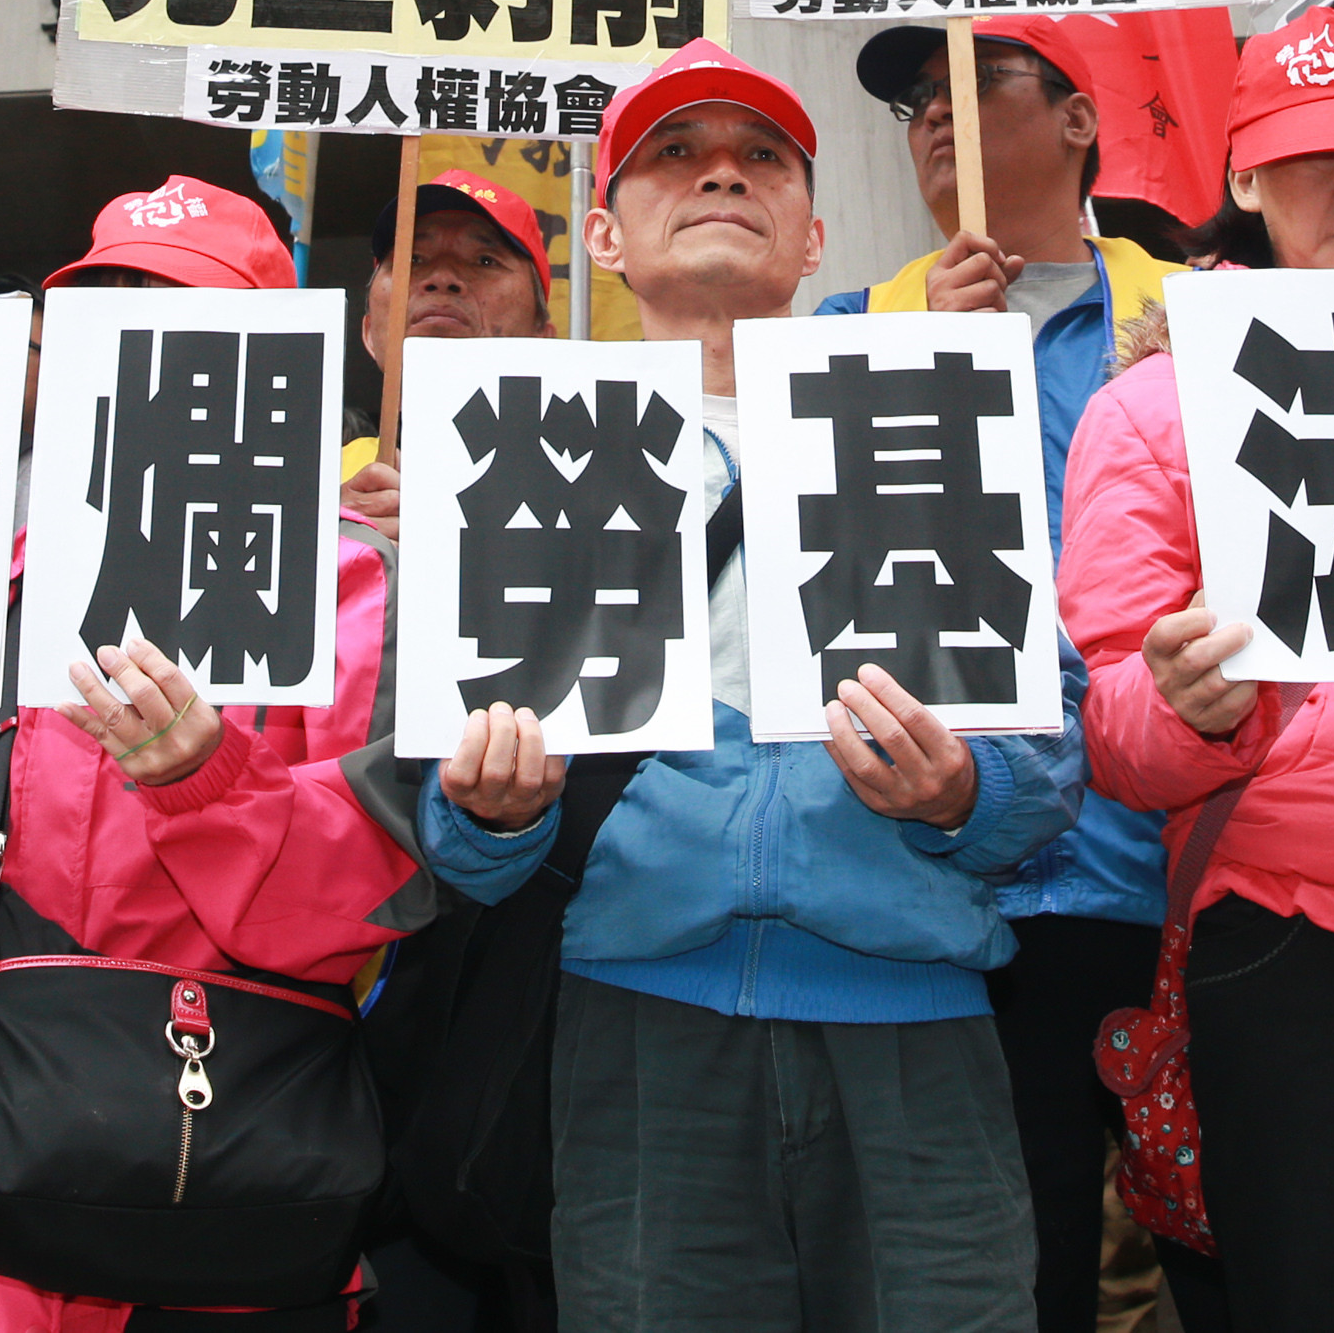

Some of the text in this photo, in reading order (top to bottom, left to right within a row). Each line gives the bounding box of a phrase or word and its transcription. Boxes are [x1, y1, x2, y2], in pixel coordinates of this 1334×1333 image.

[206, 60, 621, 136] 勞動人權協會
[78, 329, 327, 687] 爛
[452, 375, 688, 735] 勞
[789, 352, 1034, 706] 基
